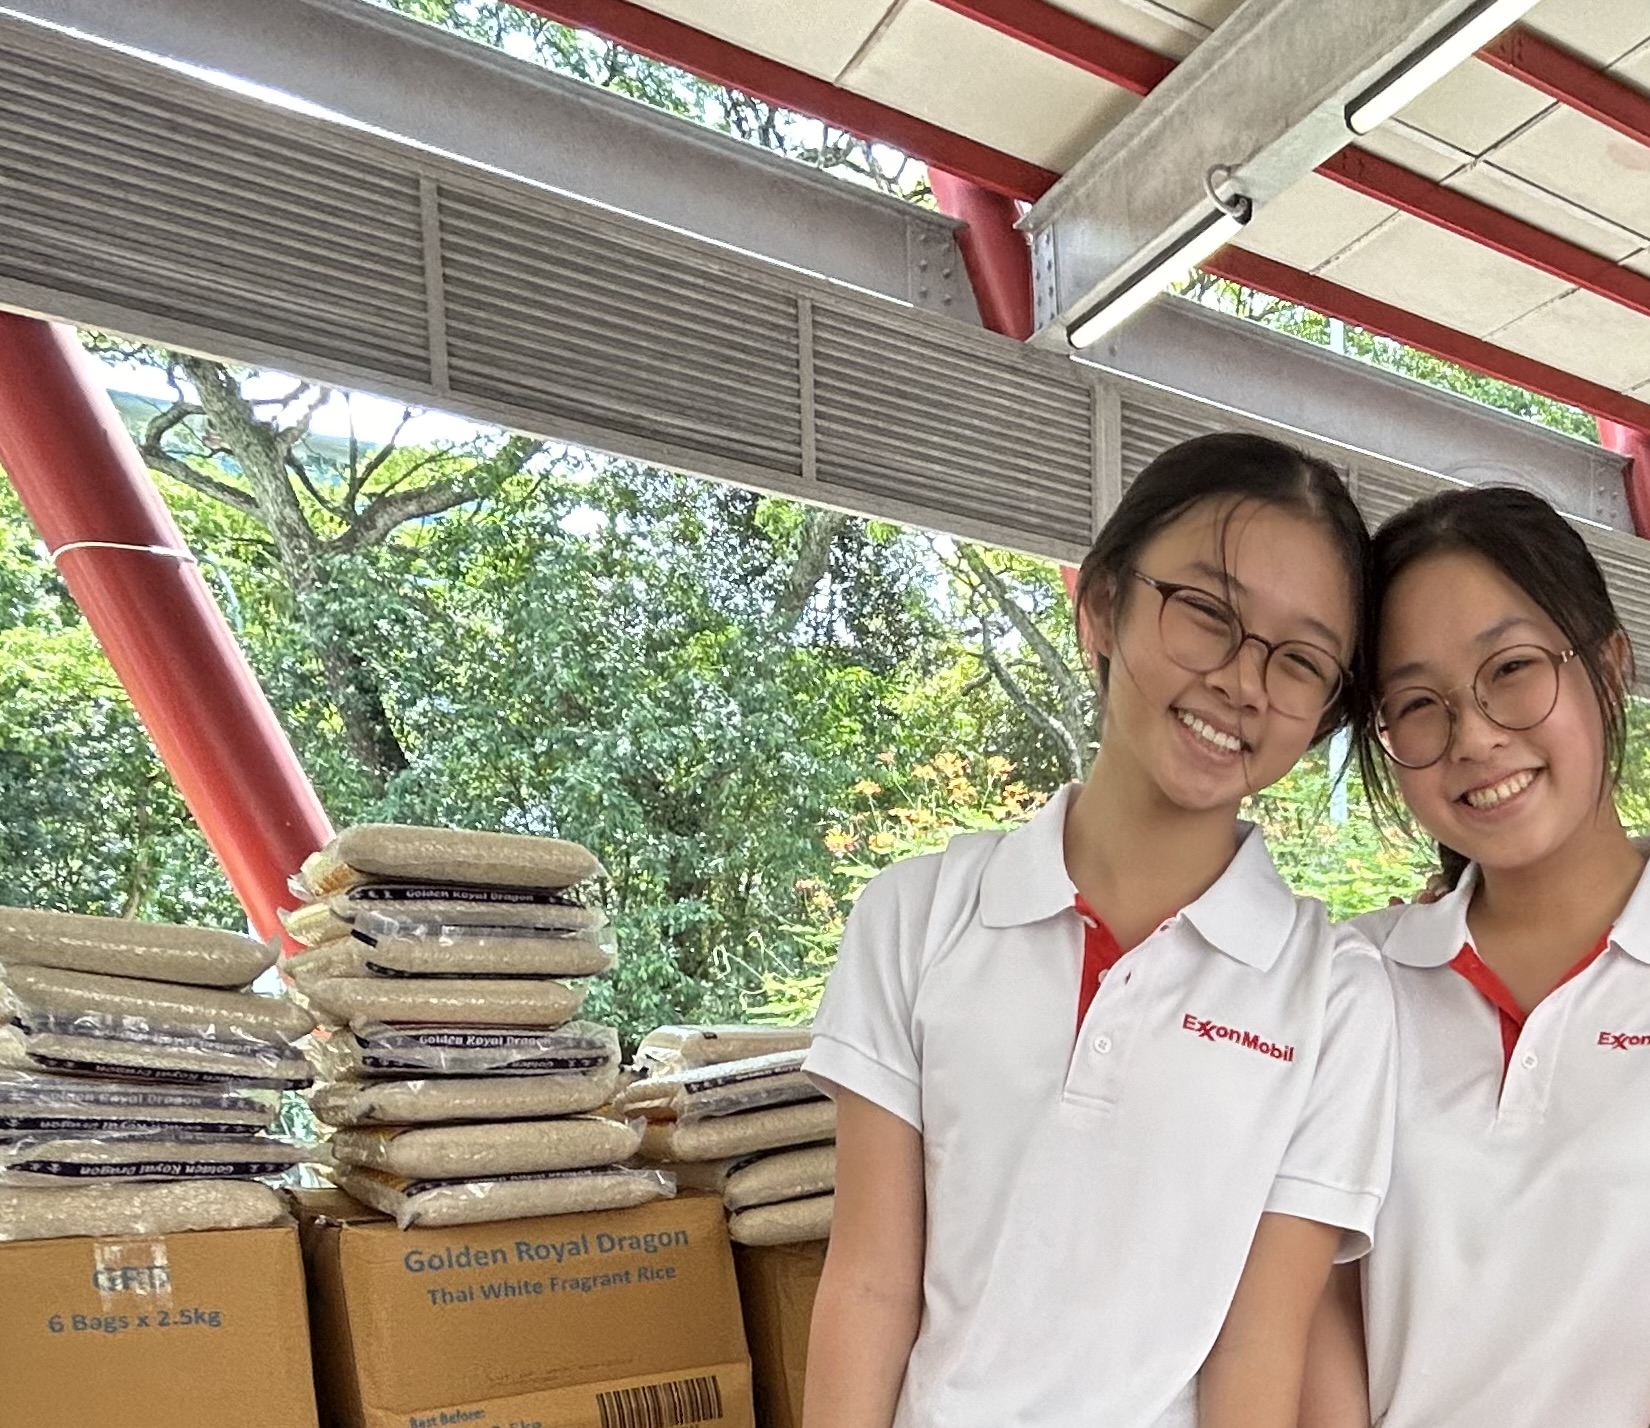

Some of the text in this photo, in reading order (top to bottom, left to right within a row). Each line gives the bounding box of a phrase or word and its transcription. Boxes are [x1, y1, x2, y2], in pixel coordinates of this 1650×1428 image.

[419, 1034, 463, 1046] Golden
[1182, 1013, 1294, 1062] ExxonMobil
[404, 1227, 690, 1273] Golden Royal Dragon
[427, 1265, 677, 1307] Thai White Fragrant Rice
[49, 1308, 222, 1333] 6 Bags x 2.5kg
